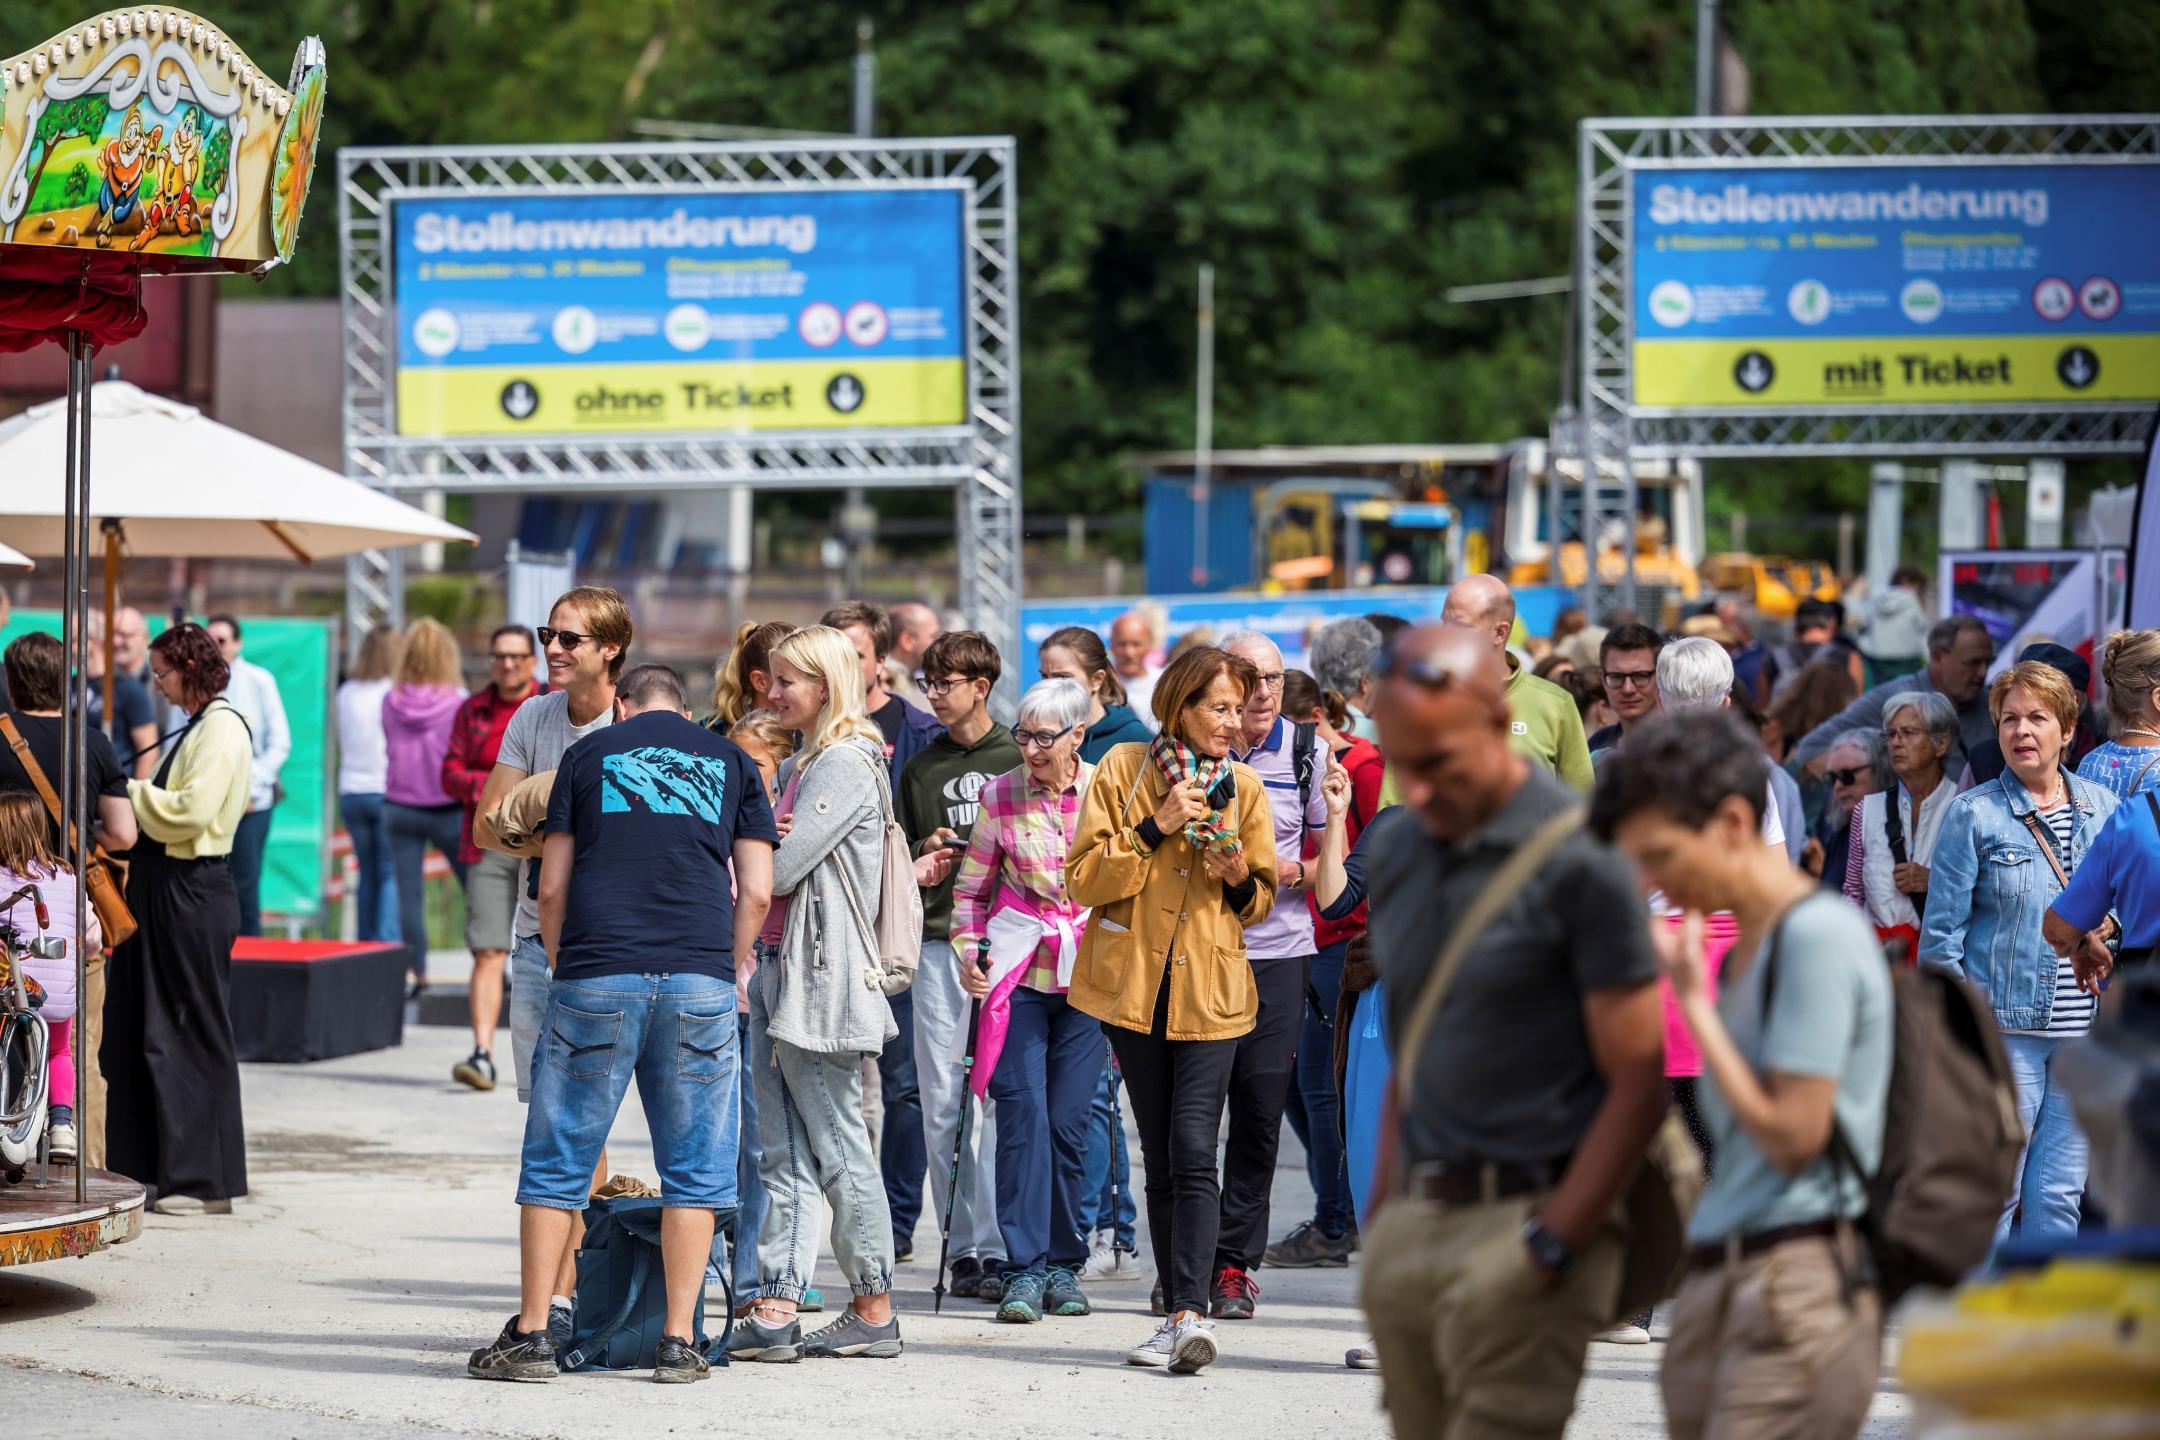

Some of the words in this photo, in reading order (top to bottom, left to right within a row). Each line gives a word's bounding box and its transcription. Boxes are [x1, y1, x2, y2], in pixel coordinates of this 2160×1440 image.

[1650, 184, 2049, 225] Stollenwanderung
[413, 212, 816, 252] Stollenwanderung
[1824, 354, 1882, 384] mit
[1897, 353, 2012, 385] Ticket
[575, 382, 665, 410] ohne
[681, 380, 792, 409] Ticket
[946, 802, 980, 828] PU
